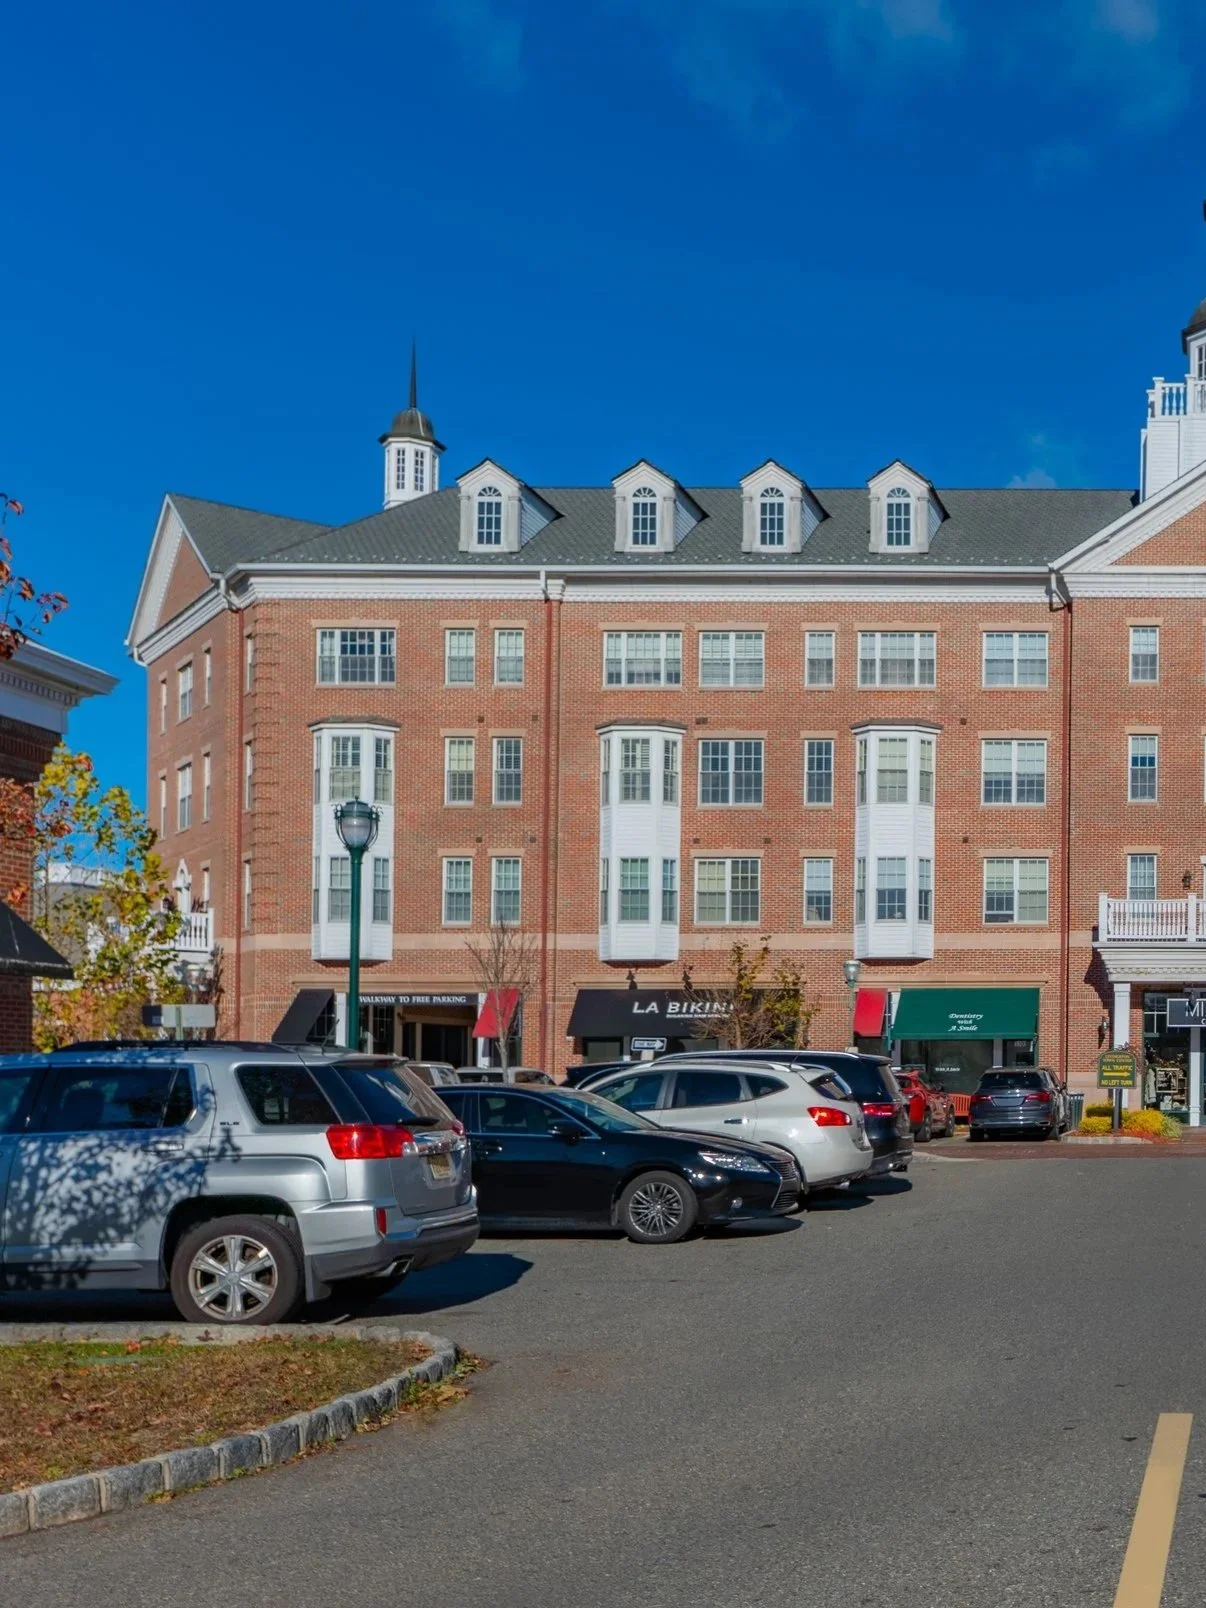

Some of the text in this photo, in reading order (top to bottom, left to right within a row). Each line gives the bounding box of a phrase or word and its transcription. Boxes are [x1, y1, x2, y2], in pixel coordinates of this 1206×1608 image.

[359, 995, 467, 1003] WALKWAY TO FREE PARKING
[632, 1001, 660, 1014] LA
[948, 1012, 984, 1020] Dentistry
[957, 1024, 979, 1032] Smile
